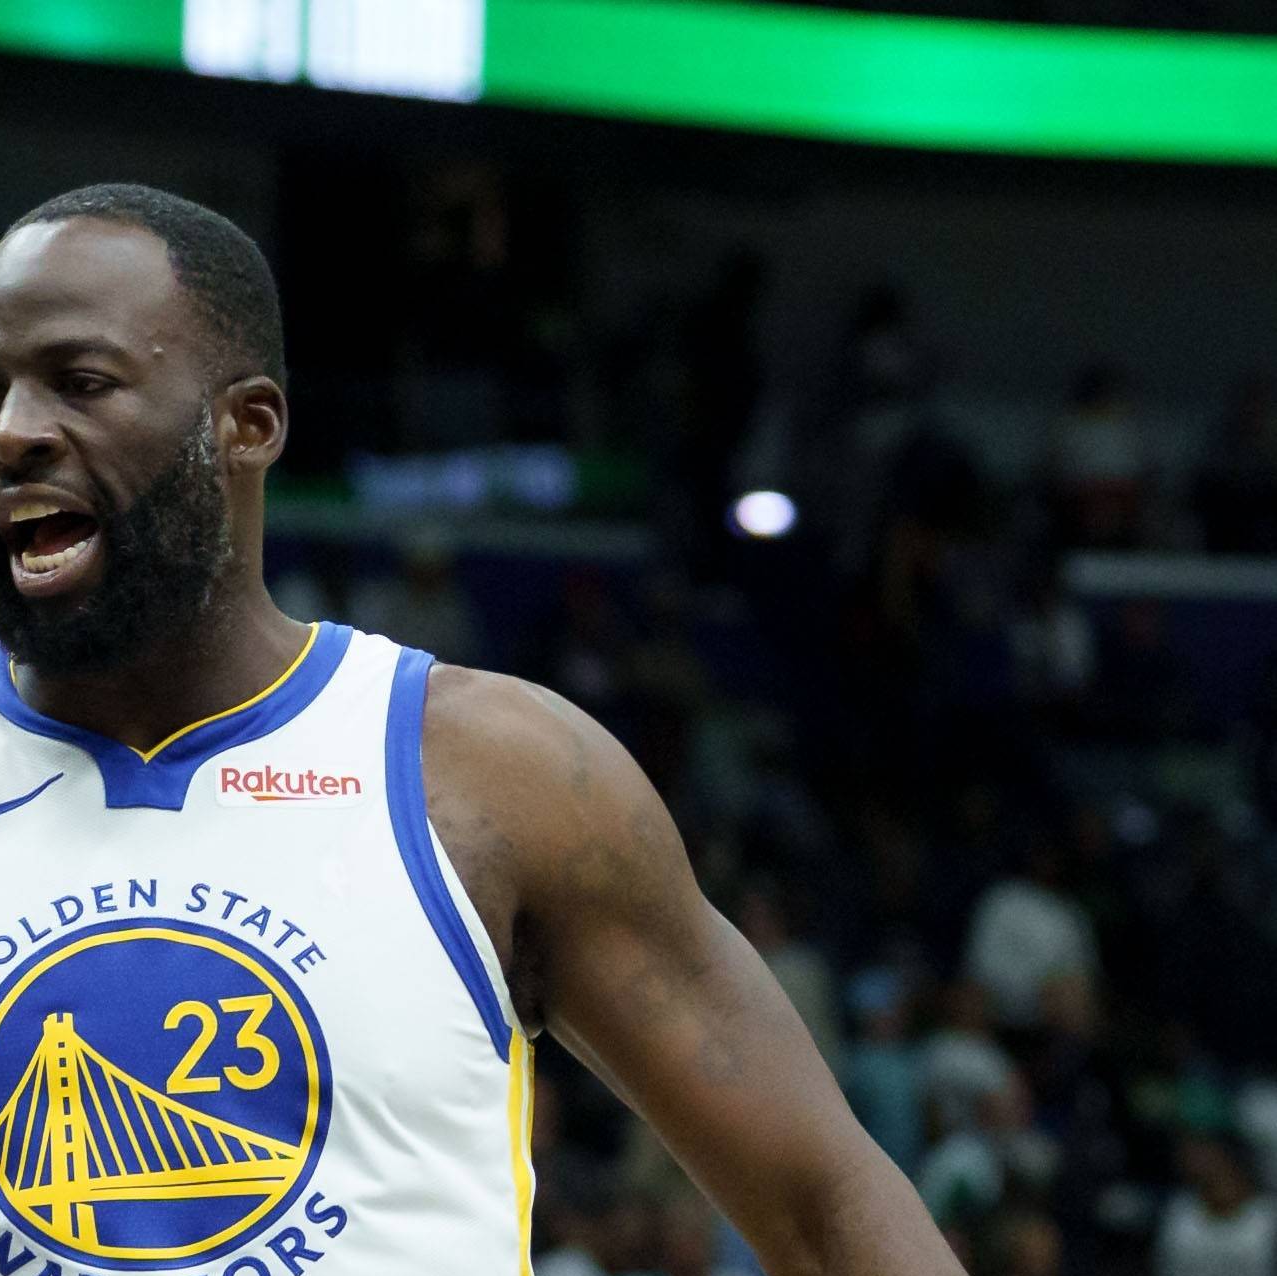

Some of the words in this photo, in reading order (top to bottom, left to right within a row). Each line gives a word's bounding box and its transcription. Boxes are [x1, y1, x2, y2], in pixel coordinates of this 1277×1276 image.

[221, 764, 362, 796] Rakuten
[185, 882, 327, 975] STATE
[163, 993, 281, 1095] 23
